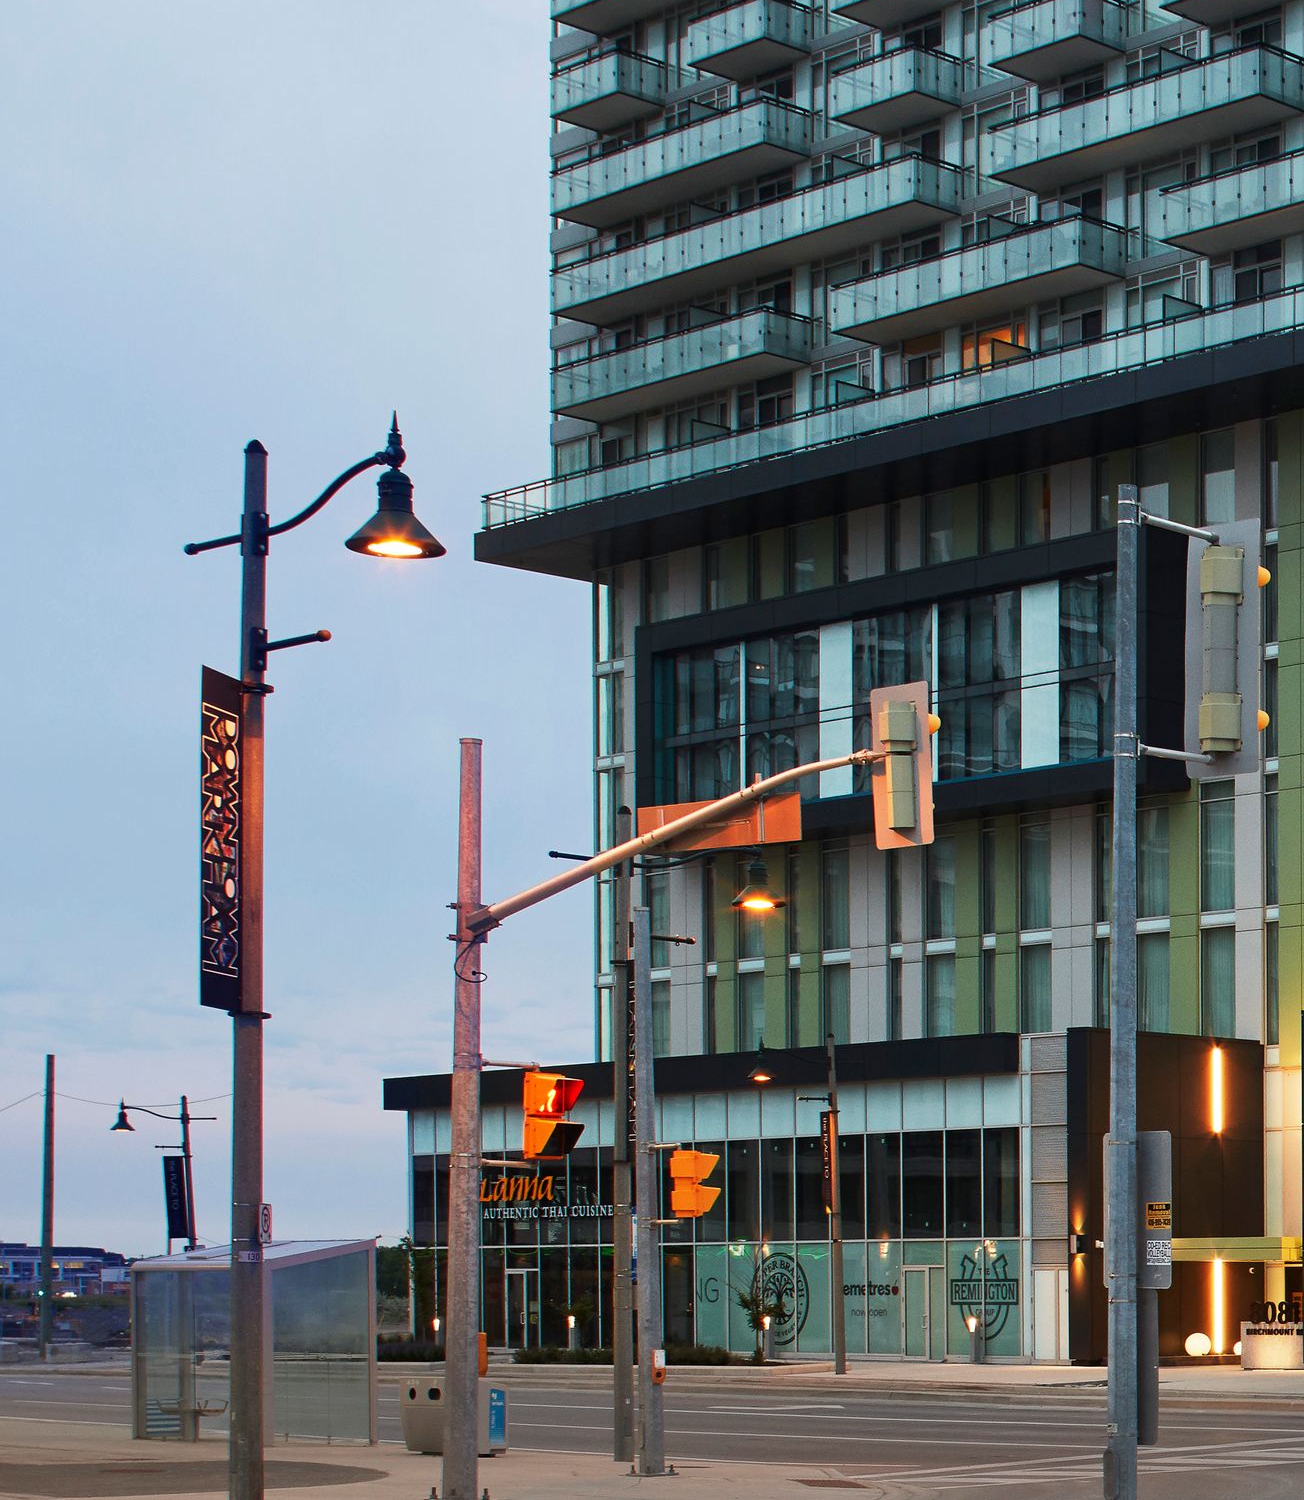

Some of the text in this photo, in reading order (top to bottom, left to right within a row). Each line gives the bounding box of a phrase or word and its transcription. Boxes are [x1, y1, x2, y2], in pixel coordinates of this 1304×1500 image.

[202, 701, 223, 973] MARKHAM
[218, 711, 239, 978] DOWNTOWN
[483, 1204, 614, 1220] AUTHENTIC THAI CUISINE
[869, 1309, 888, 1318] open
[1246, 1328, 1295, 1336] BIRCHMOUNT
